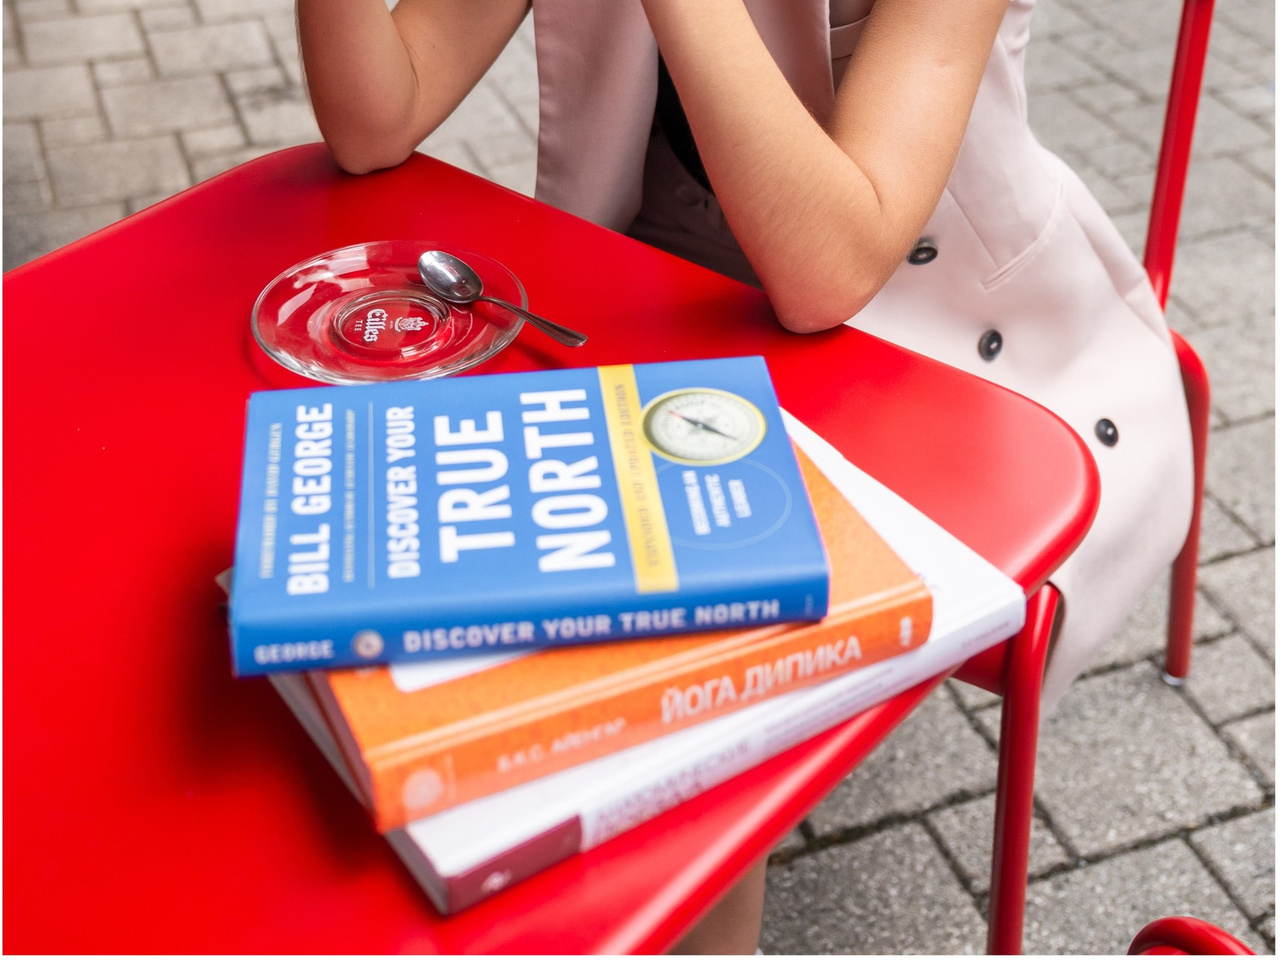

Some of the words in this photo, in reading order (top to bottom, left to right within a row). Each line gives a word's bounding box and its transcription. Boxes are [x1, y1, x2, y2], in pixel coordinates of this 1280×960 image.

[354, 320, 363, 331] TEE
[291, 403, 333, 515] GEORGE
[386, 406, 416, 463] YOUR
[387, 465, 421, 579] DISCOVER
[434, 410, 515, 563] TRUE
[520, 389, 616, 573] NORTH
[286, 524, 331, 595] BILL
[253, 639, 336, 665] GEORGE
[403, 620, 536, 653] DISCOVER
[542, 614, 612, 640] YOUR
[619, 607, 688, 633] TRUE
[695, 599, 780, 626] NORTH
[661, 680, 738, 725] ЙОГА
[740, 635, 863, 702] ДИПИКА
